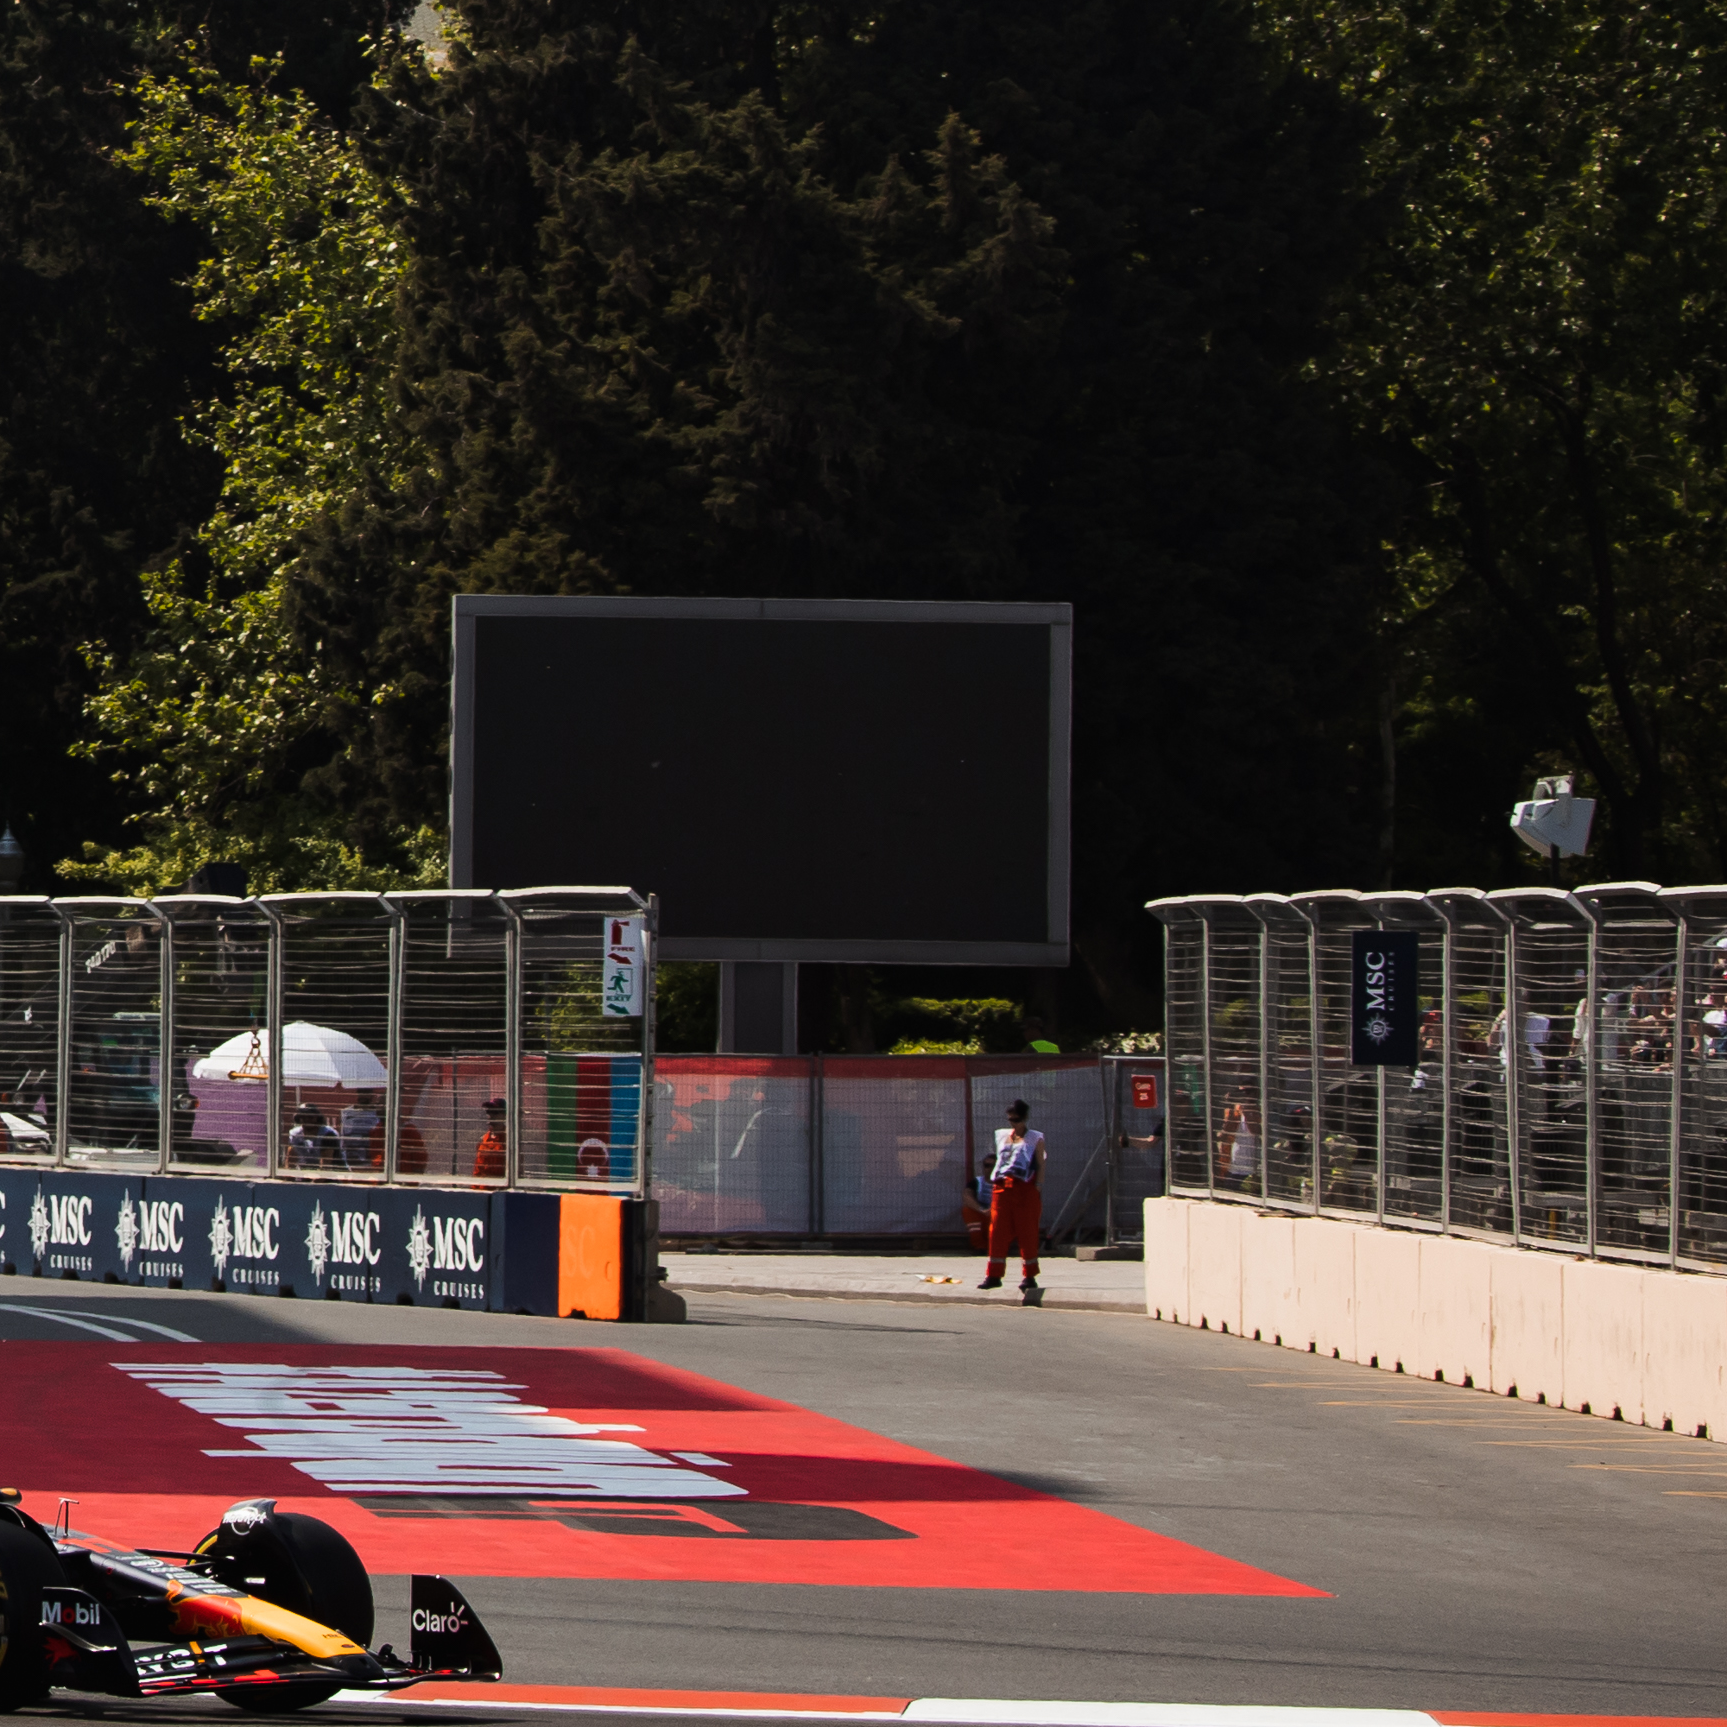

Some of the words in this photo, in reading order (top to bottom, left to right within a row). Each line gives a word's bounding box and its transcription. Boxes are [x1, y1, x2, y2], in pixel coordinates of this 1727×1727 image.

[1366, 952, 1385, 1011] MSC
[50, 1194, 92, 1246] MSC
[139, 1200, 184, 1254] MSC
[232, 1206, 280, 1260] MSC
[331, 1211, 381, 1265] MSC
[432, 1216, 484, 1272] MSC
[49, 1254, 93, 1271] CRUISES
[138, 1261, 184, 1278] CRUISES
[232, 1268, 280, 1286] CRUISES
[330, 1274, 382, 1293] CRUISES
[433, 1281, 485, 1300] CRUISES
[42, 1601, 101, 1626] Mobil
[412, 1609, 460, 1634] Claro
